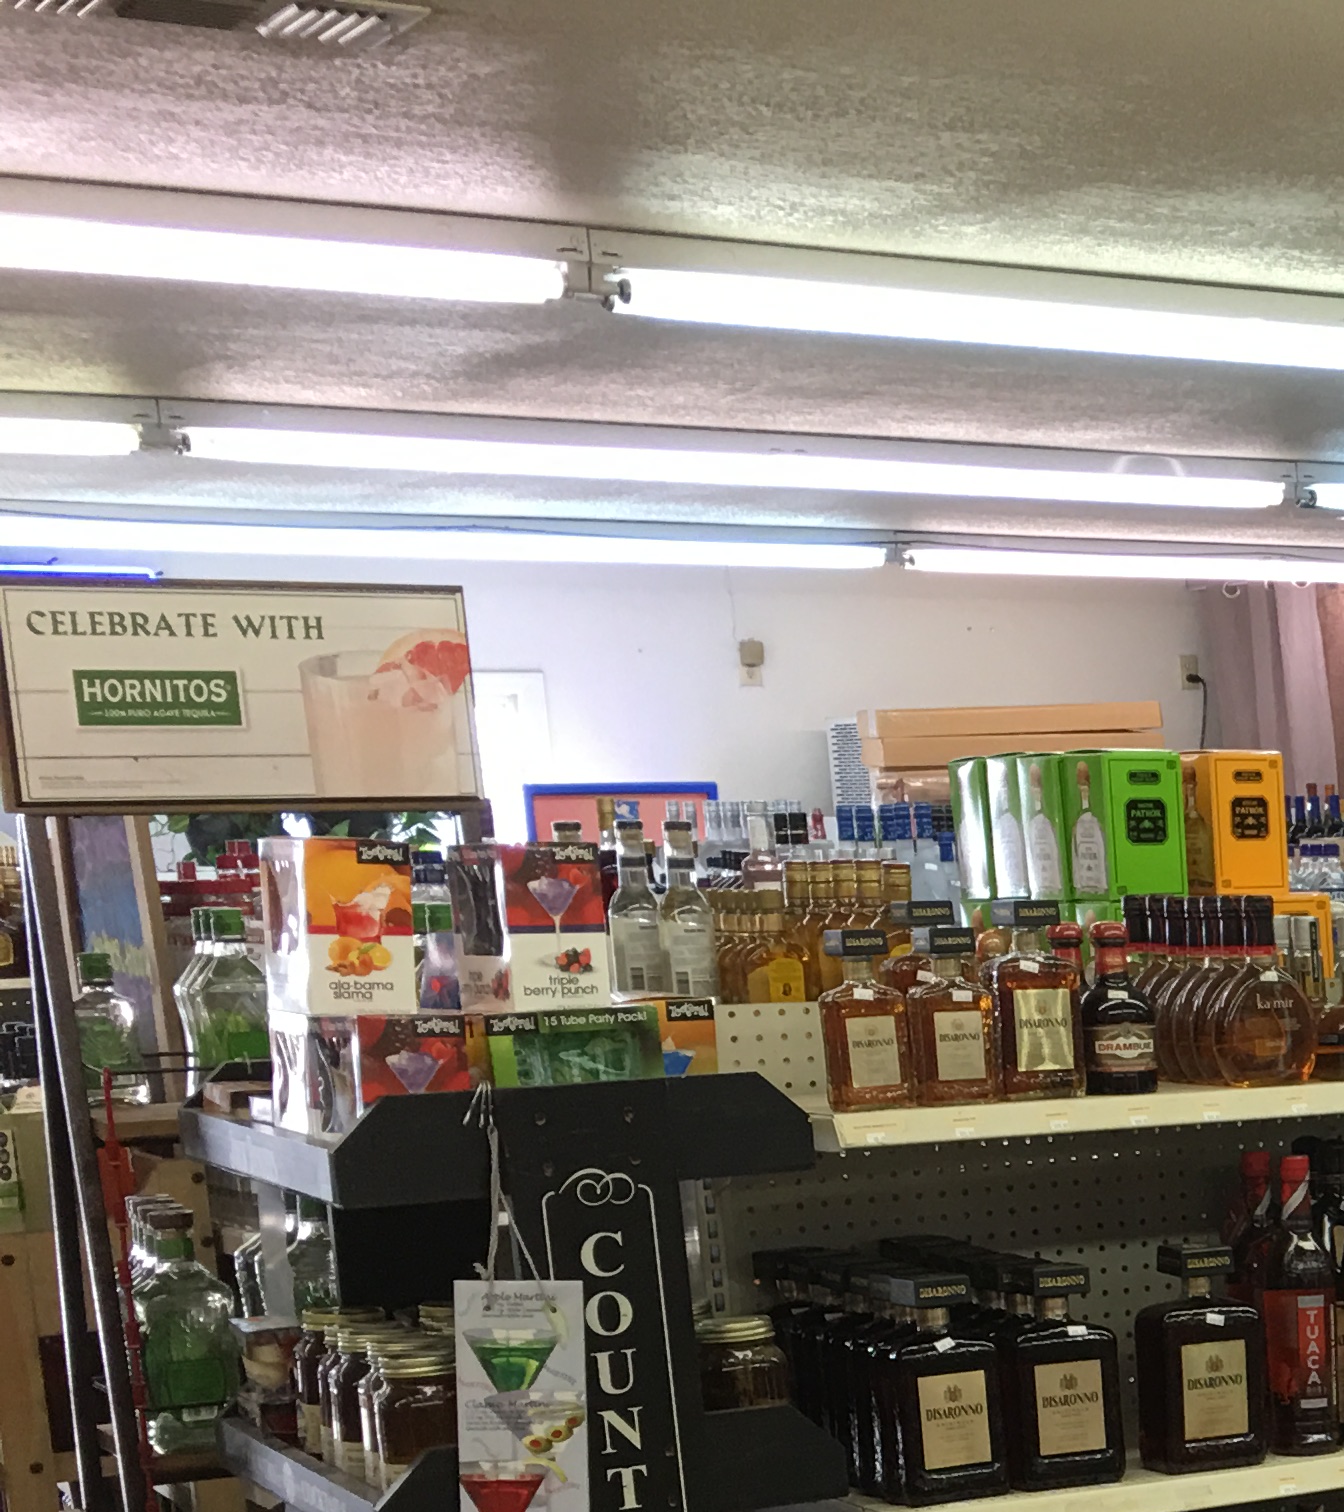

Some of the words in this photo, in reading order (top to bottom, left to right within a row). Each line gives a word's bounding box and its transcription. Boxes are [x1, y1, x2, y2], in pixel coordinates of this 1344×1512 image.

[26, 610, 218, 638] CELEBRATE
[232, 614, 325, 640] WITH
[81, 678, 229, 703] HORNITOS
[548, 973, 580, 988] triple
[333, 987, 373, 1000] slama
[523, 985, 557, 999] berry
[560, 984, 599, 999] punch
[558, 1013, 586, 1026] Tube
[588, 1012, 615, 1027] Party
[618, 1010, 647, 1023] Pack!
[1018, 1017, 1068, 1031] DISARONNO
[851, 1037, 898, 1048] DISARONNO
[939, 1032, 981, 1043] DISARONNO
[1097, 1040, 1154, 1052] DRAMBUIE
[1187, 1255, 1231, 1270] DISARONNO
[1038, 1274, 1086, 1288] DISARONNO
[918, 1283, 967, 1299] DISARONNO
[1306, 1309, 1322, 1386] TUACA
[1186, 1371, 1244, 1391] DISARONNO
[1041, 1390, 1099, 1409] DISARONNO
[925, 1401, 984, 1422] DISARONNO
